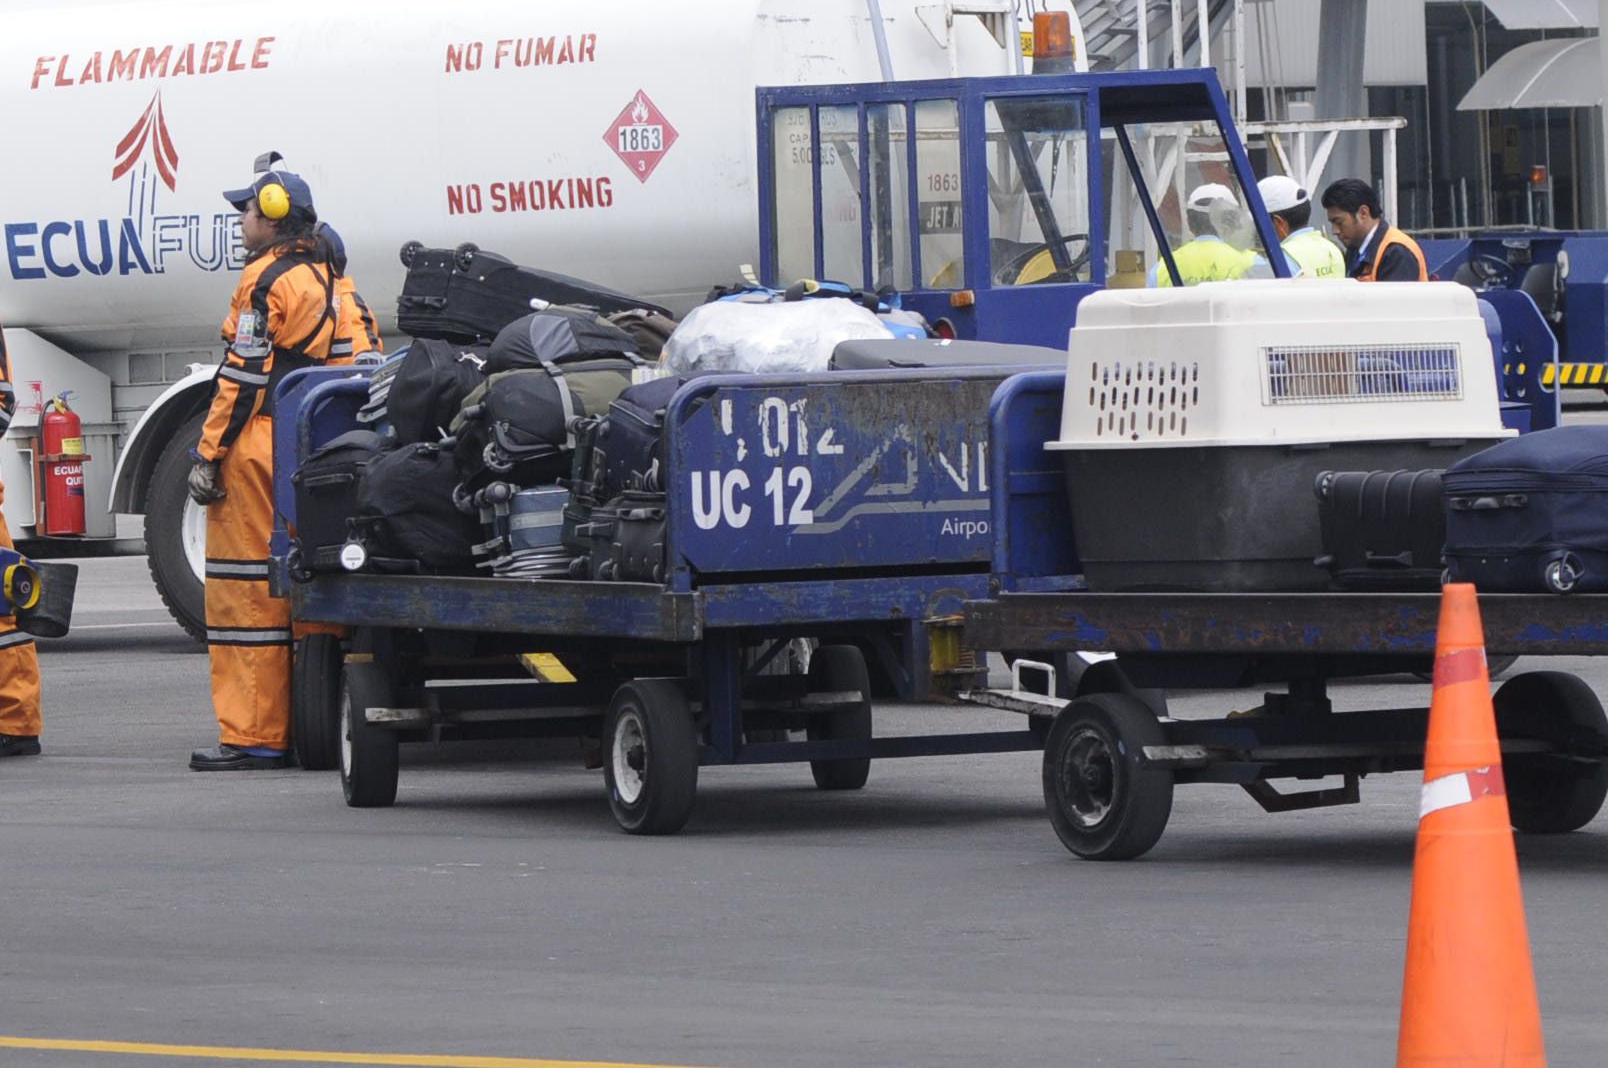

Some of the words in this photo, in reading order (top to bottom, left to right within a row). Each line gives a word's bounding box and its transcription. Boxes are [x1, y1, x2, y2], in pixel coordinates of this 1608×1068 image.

[30, 36, 276, 89] FLAMMABLE
[445, 42, 483, 72] NO
[494, 33, 597, 69] FUMAR
[619, 127, 661, 151] 1863
[638, 160, 646, 172] 3
[447, 184, 483, 215] NO
[490, 177, 613, 212] SMOKING
[928, 174, 958, 192] 1863
[926, 206, 948, 229] JET
[4, 214, 244, 280] ECUAFUE
[692, 469, 751, 530] UC
[765, 466, 814, 526] 12
[941, 518, 990, 539] Airpo
